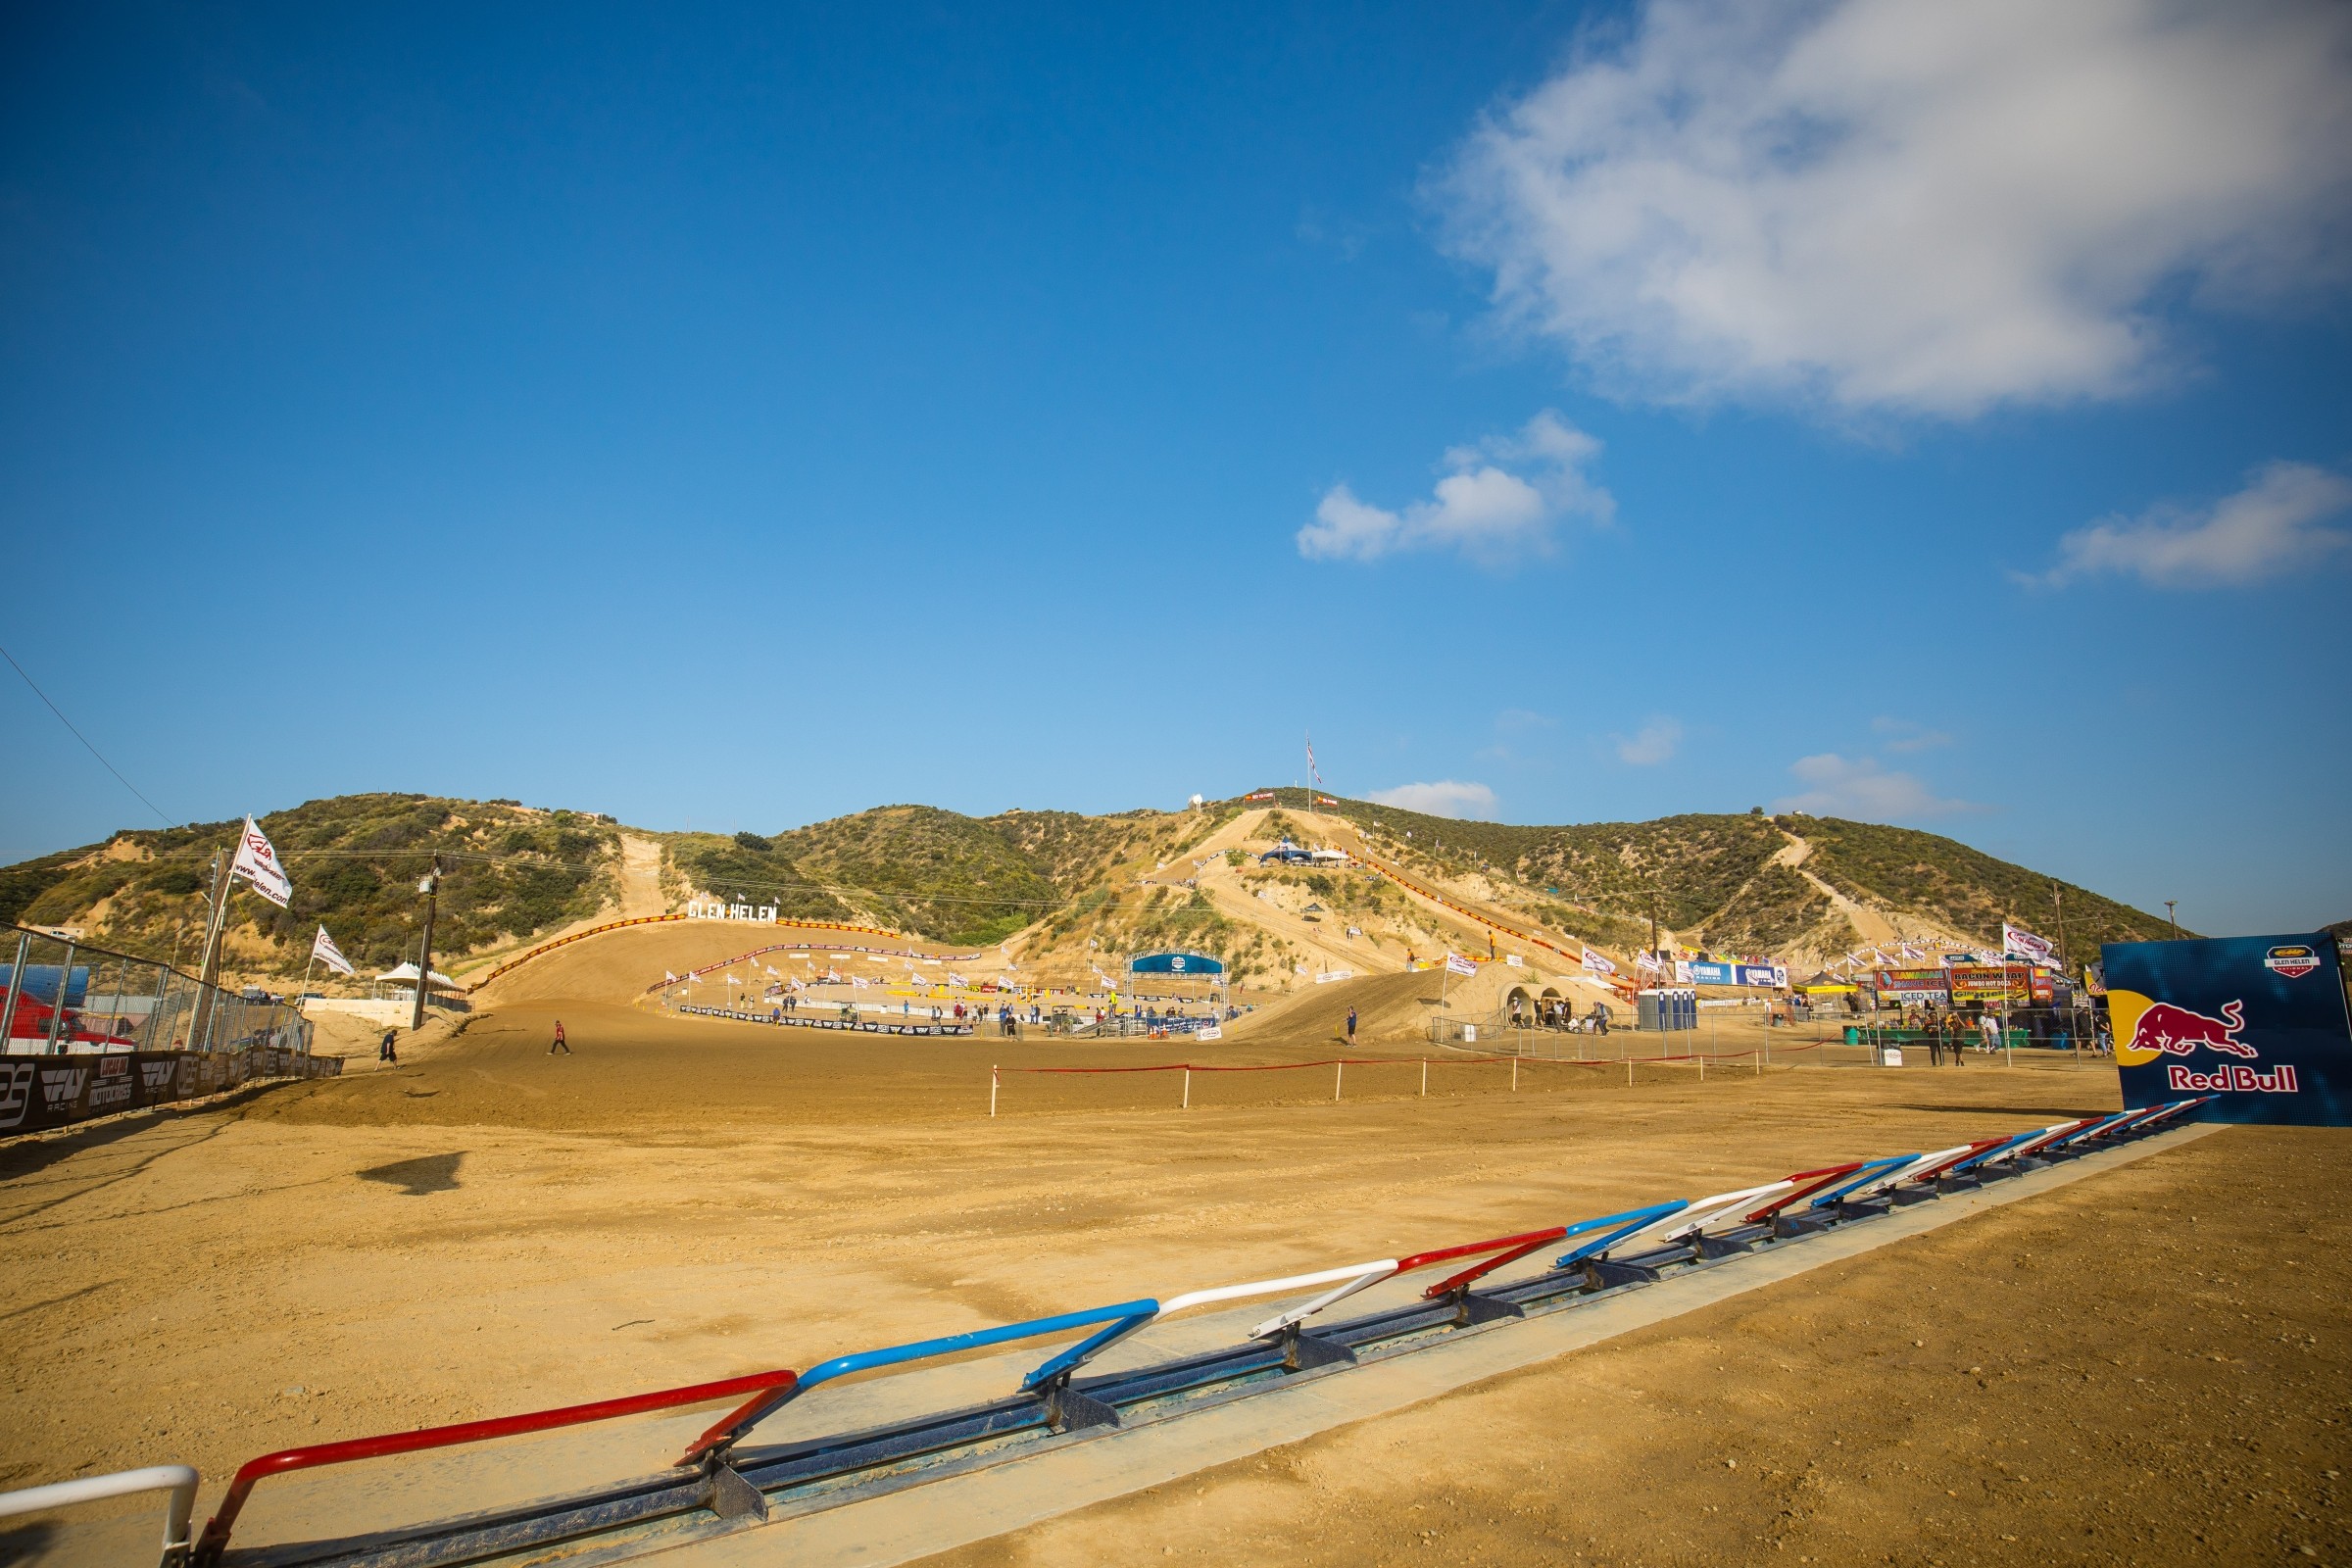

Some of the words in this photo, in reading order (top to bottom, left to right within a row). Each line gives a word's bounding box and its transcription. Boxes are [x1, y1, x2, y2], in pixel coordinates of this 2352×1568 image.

[688, 901, 726, 919] GLEN
[730, 904, 777, 922] HELEN
[1699, 965, 1721, 976] YAMAHA
[2168, 1064, 2232, 1091] Red
[2231, 1065, 2298, 1092] Bull
[89, 1083, 132, 1106] MOTOCROSS
[47, 1101, 78, 1113] RACING
